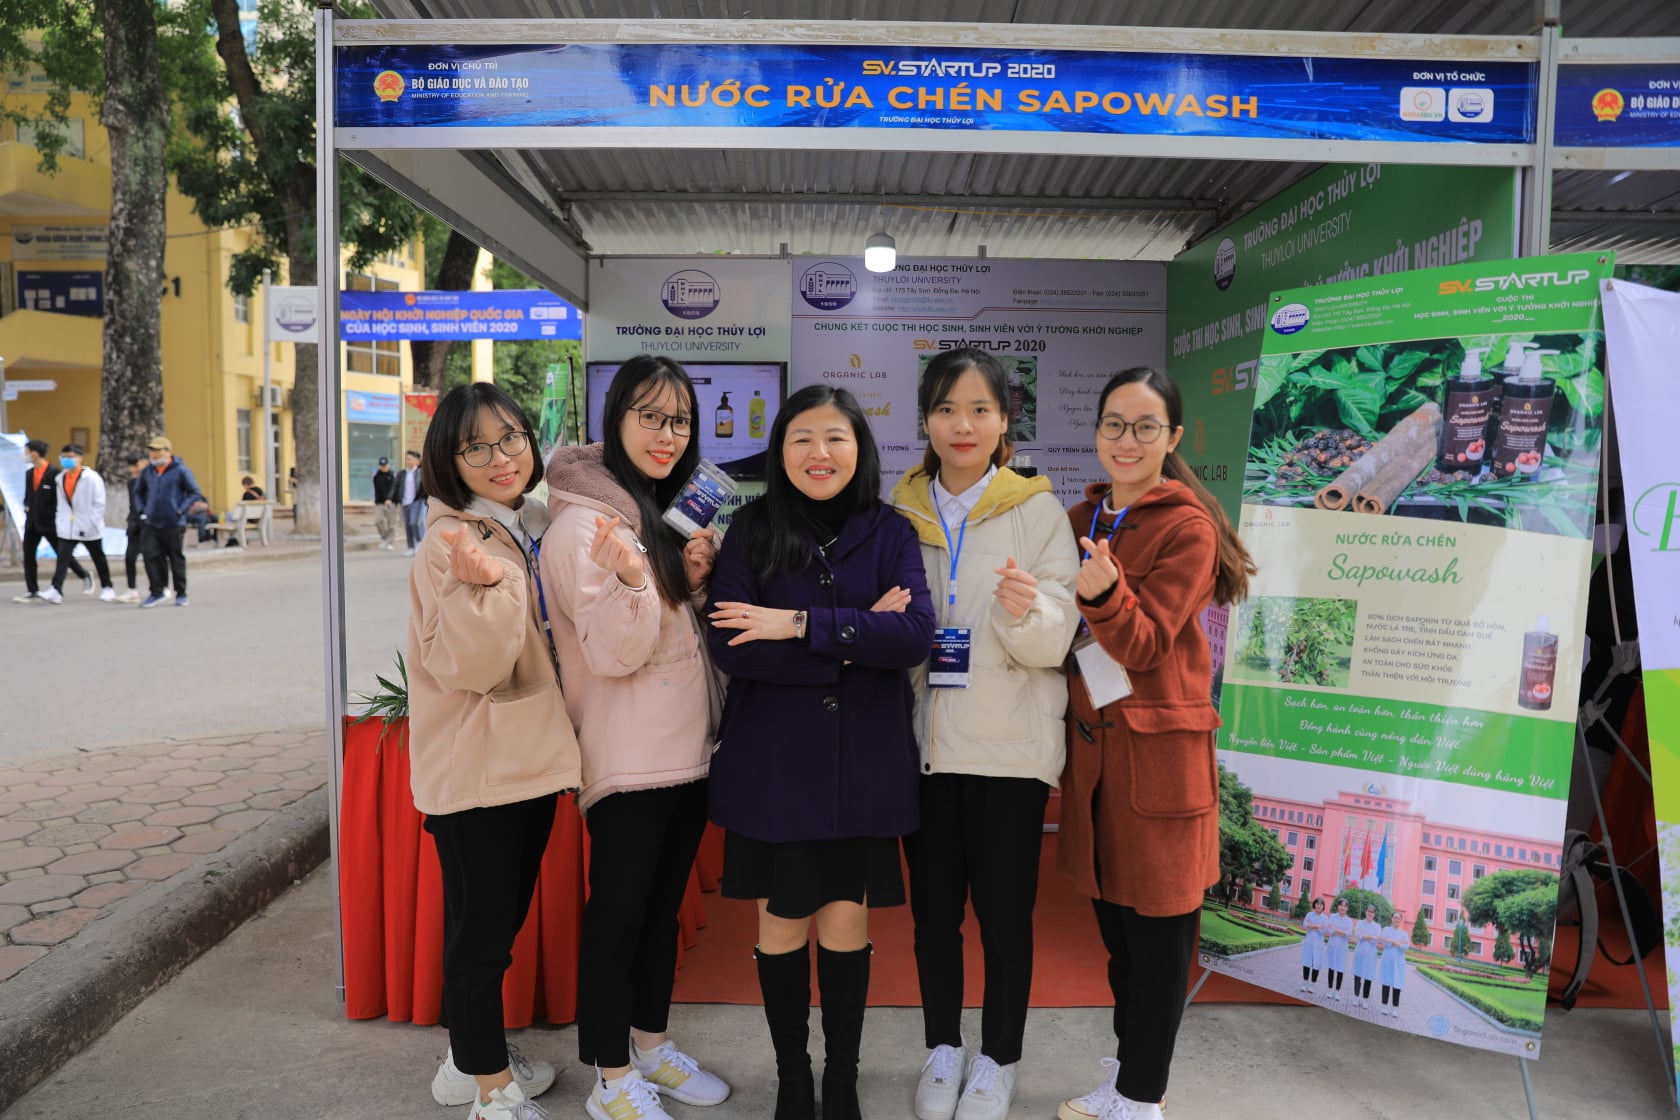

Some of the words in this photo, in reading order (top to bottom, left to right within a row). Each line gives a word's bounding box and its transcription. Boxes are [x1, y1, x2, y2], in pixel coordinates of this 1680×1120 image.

[428, 61, 449, 71] ĐƠN
[450, 62, 460, 73] VỊ
[462, 60, 482, 71] CHỦ
[485, 60, 498, 71] TRÌ
[1007, 63, 1056, 79] 2020
[412, 76, 425, 91] BỘ
[428, 76, 450, 89] GIÁO
[452, 78, 471, 91] DỤC
[474, 76, 487, 89] VÀ
[489, 76, 508, 90] ĐÀO
[511, 78, 529, 91] TẠO
[1413, 72, 1434, 81] ĐƠN
[1435, 73, 1445, 83] VỊ
[1446, 71, 1459, 81] TỔ
[1460, 72, 1486, 82] CHỨC
[1648, 80, 1671, 90] ĐƠN
[649, 80, 771, 108] NƯỚC
[786, 77, 874, 109] RỬA
[888, 82, 1002, 112] CHÉN
[1018, 90, 1258, 119] SAPOWASH
[1630, 94, 1644, 111] BỘ
[1646, 93, 1670, 109] GIÁO
[880, 115, 909, 123] TRƯỜNG
[910, 116, 923, 124] ĐẠI
[1243, 217, 1279, 251] TRƯỜNG
[1280, 206, 1298, 233] ĐẠI
[1300, 191, 1325, 221] HỌC
[1327, 170, 1357, 205] THỦY
[1360, 163, 1382, 191] LỢI
[1260, 239, 1297, 270] THUYLOI
[1297, 209, 1353, 254] UNIVERSITY
[912, 264, 928, 275] ĐẠI
[931, 265, 949, 275] HỌC
[952, 263, 974, 274] THỦY
[975, 265, 991, 276] LỢI
[872, 275, 909, 285] THUYLOI
[911, 276, 962, 286] UNIVERSITY
[1372, 288, 1390, 298] THỦY
[1496, 295, 1519, 304] CUỘC
[1521, 294, 1535, 302] THI
[470, 306, 502, 321] QUỐC
[504, 309, 524, 321] GIA
[1414, 312, 1430, 320] HỌC
[1452, 308, 1472, 317] SINH
[1473, 306, 1492, 315] VIÊN
[1502, 313, 1525, 322] 2020
[346, 320, 371, 334] CỦA
[372, 322, 397, 337] HỌC
[399, 322, 429, 336] SINH,
[431, 322, 460, 334] SINH
[461, 320, 488, 334] VIÊN
[489, 322, 518, 333] 2020
[616, 323, 662, 337] TRƯỜNG
[665, 326, 685, 339] ĐẠI
[688, 327, 714, 339] HỌC
[717, 323, 744, 337] THỦY
[748, 325, 767, 340] LỢI
[814, 322, 848, 332] CHUNG
[850, 321, 869, 332] KẾT
[871, 322, 899, 334] CUỘC
[902, 323, 917, 332] THI
[919, 323, 939, 335] HỌC
[942, 324, 967, 335] SINH,
[969, 324, 990, 334] SINH
[993, 323, 1015, 334] VIÊN
[1017, 324, 1034, 334] VỚI
[1036, 323, 1043, 334] Ý
[1109, 326, 1143, 337] NGHIỆP
[1173, 330, 1191, 360] CUỘC
[1192, 327, 1203, 352] THI
[1204, 320, 1220, 351] HỌC
[1221, 312, 1243, 342] SINH,
[1245, 302, 1268, 334] SINH
[640, 341, 683, 352] THUYLOI
[685, 341, 741, 352] UNIVERSITY
[1014, 339, 1047, 353] 2020
[822, 371, 866, 379] ORGANIC
[869, 371, 888, 379] LAB
[1211, 464, 1228, 481] LAB
[1335, 532, 1378, 545] NƯỚC
[1381, 531, 1412, 547] RỬA
[1416, 533, 1456, 548] CHÉN
[1327, 552, 1465, 588] Sapowash
[1366, 623, 1389, 631] NƯỚC
[1403, 637, 1424, 646] CHÉN
[1363, 646, 1389, 655] KHÔNG
[1390, 648, 1405, 656] GÂY
[1407, 649, 1425, 658] KÍCH
[1375, 659, 1393, 667] TOÀN
[1395, 661, 1412, 669] CHO
[1361, 670, 1381, 678] THÂN
[1283, 695, 1307, 709] Sạch
[1332, 704, 1345, 713] an
[1348, 703, 1371, 715] toàn
[1399, 708, 1425, 722] thân
[1429, 712, 1458, 727] thiện
[1298, 720, 1323, 735] Đồng
[1325, 722, 1351, 736] hành
[1354, 728, 1378, 741] cùng
[1380, 731, 1406, 744] nông
[1409, 733, 1432, 745] dân
[1435, 735, 1461, 750] Việt
[1228, 732, 1259, 747] Nguyên
[1260, 737, 1275, 750] liệu
[1279, 739, 1298, 753] Việt
[1309, 743, 1328, 757] Sản
[1330, 747, 1359, 761] phẩm
[1362, 749, 1385, 765] Việt
[1399, 755, 1432, 771] Người
[1435, 759, 1460, 775] Việt
[1462, 765, 1491, 783] dùng
[1495, 770, 1525, 787] hàng
[1529, 773, 1556, 790] Việt
